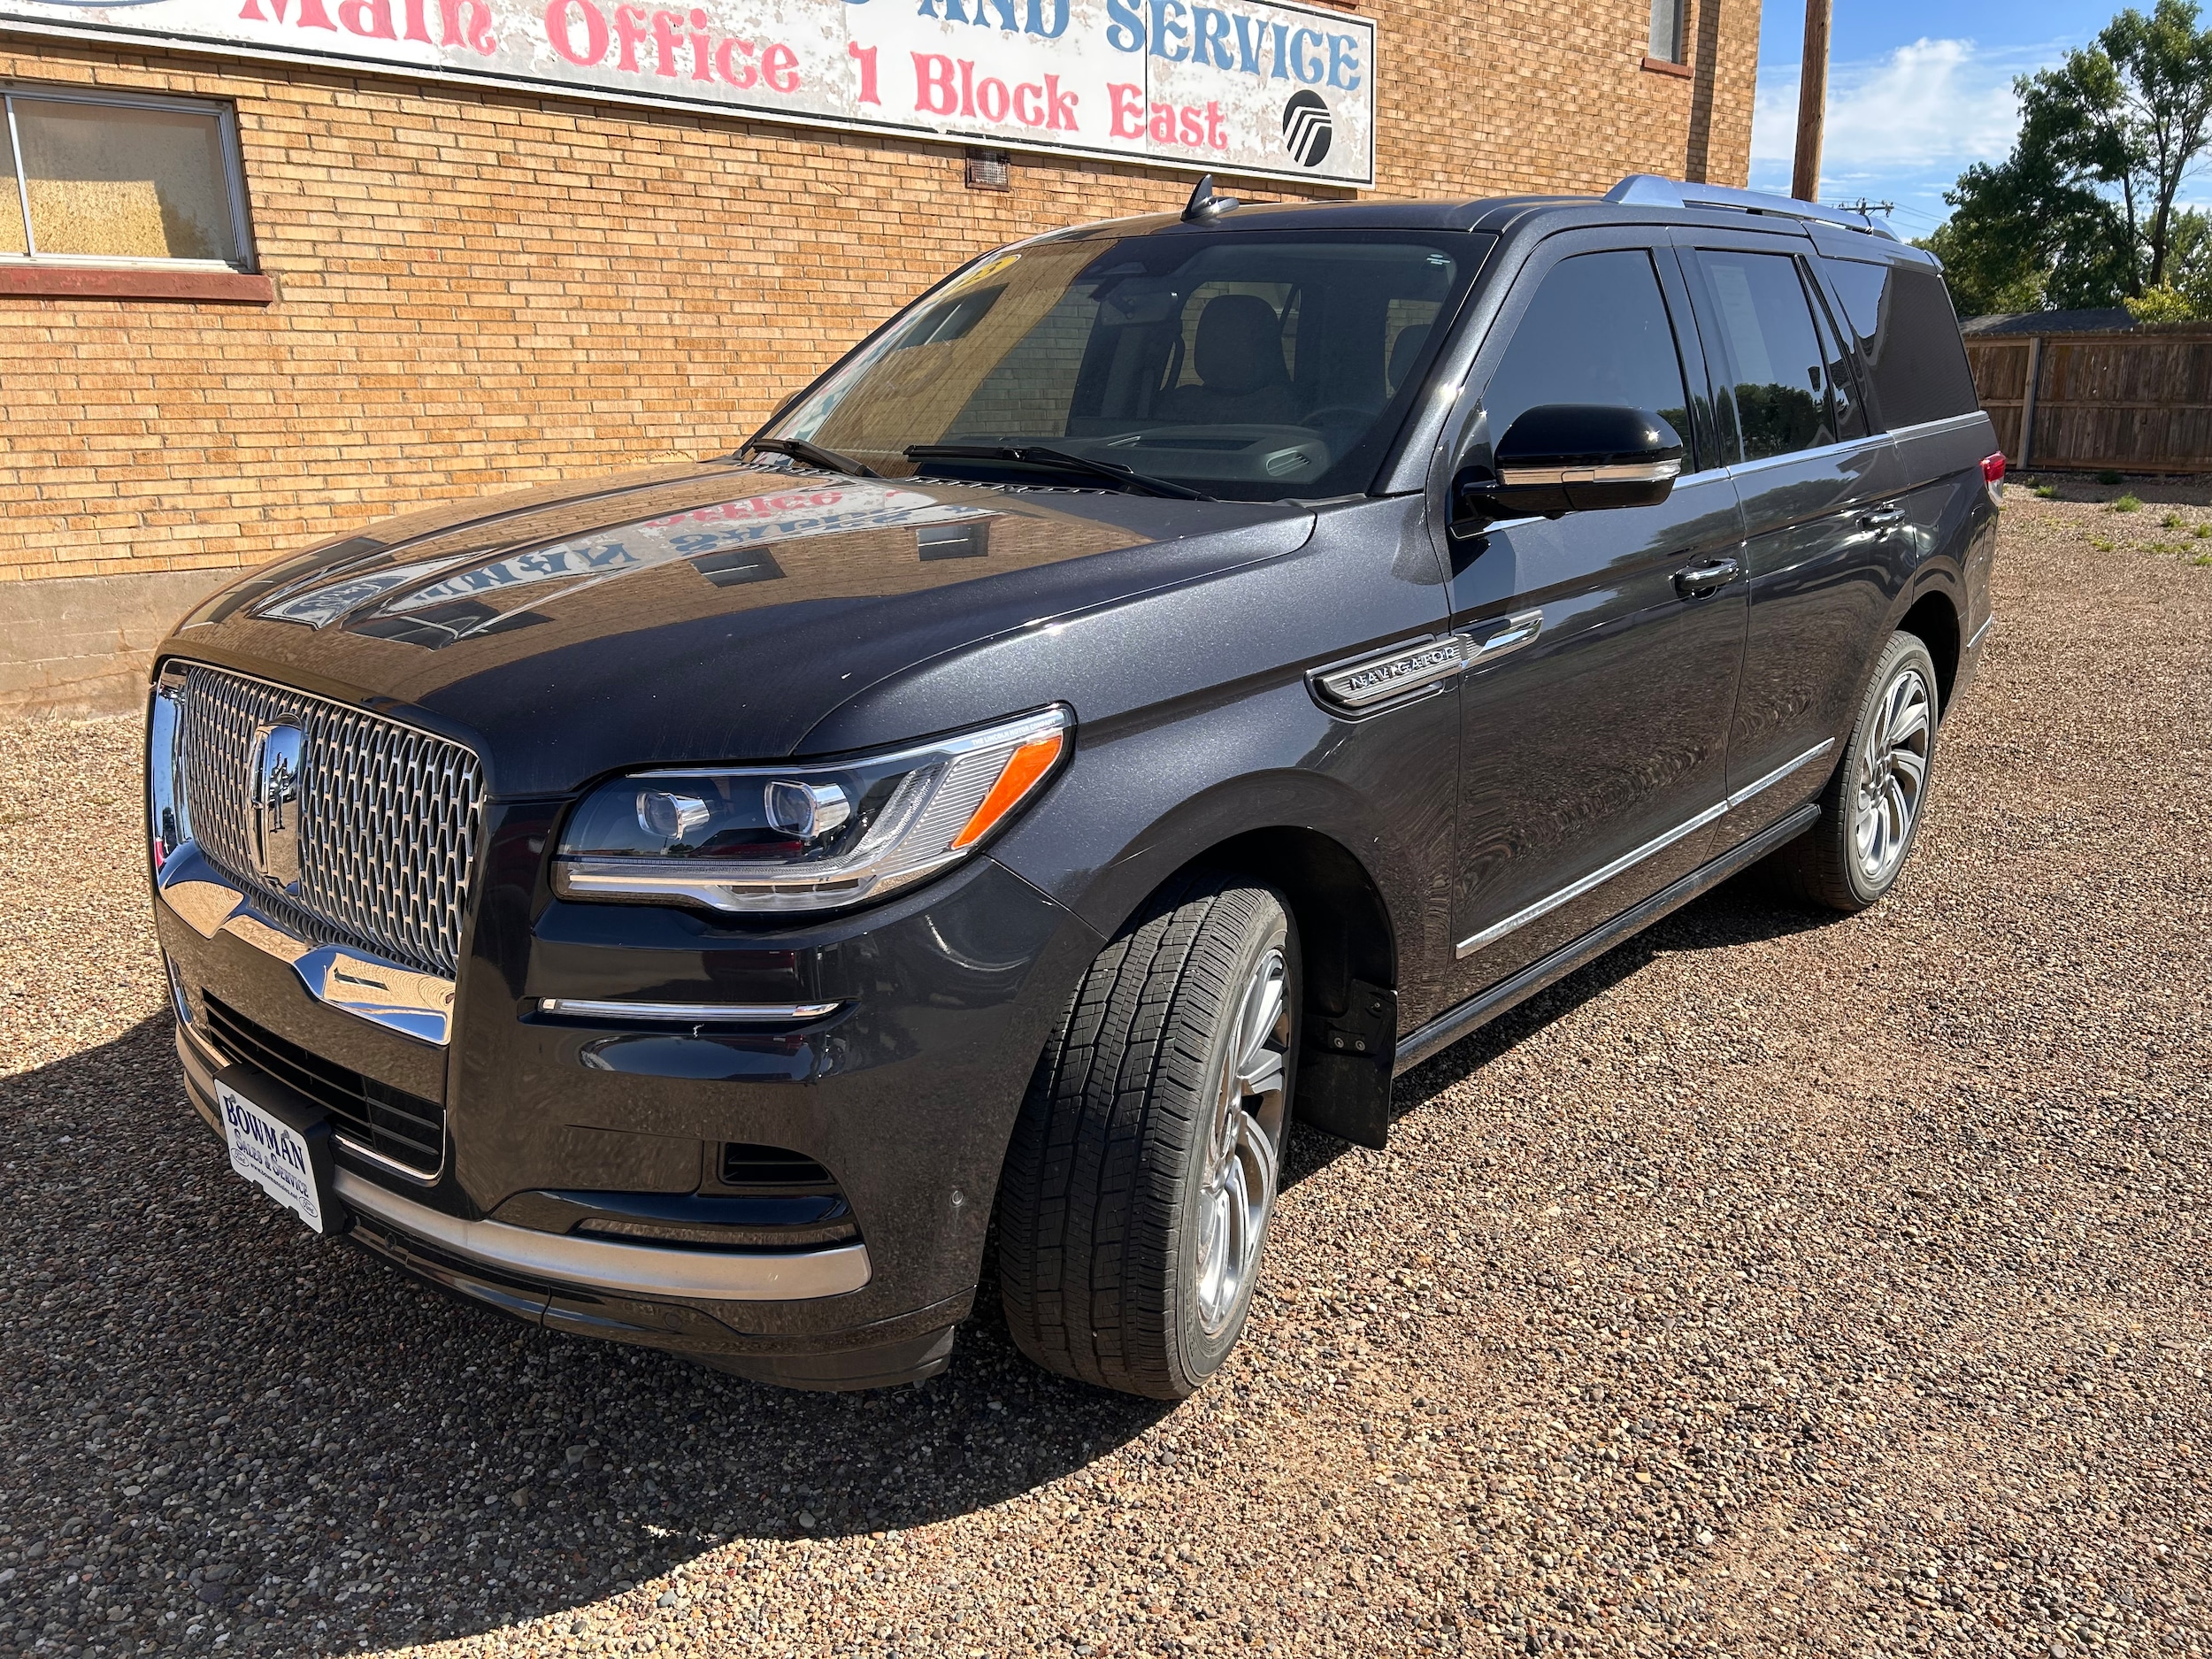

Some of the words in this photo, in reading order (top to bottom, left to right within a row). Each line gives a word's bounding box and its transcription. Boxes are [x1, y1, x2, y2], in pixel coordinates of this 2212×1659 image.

[544, 0, 801, 94] Office
[849, 41, 881, 105] 1
[910, 50, 1079, 131] Block
[1107, 82, 1228, 150] East
[1106, 0, 1362, 91] SERVICE
[1349, 646, 1455, 690] NAVIGATOR
[972, 737, 984, 746] THE
[984, 732, 1009, 743] LINCOLN
[1009, 726, 1030, 736] MOTOR
[1030, 718, 1056, 730] COMPANY
[223, 1095, 306, 1175] BOWMAN
